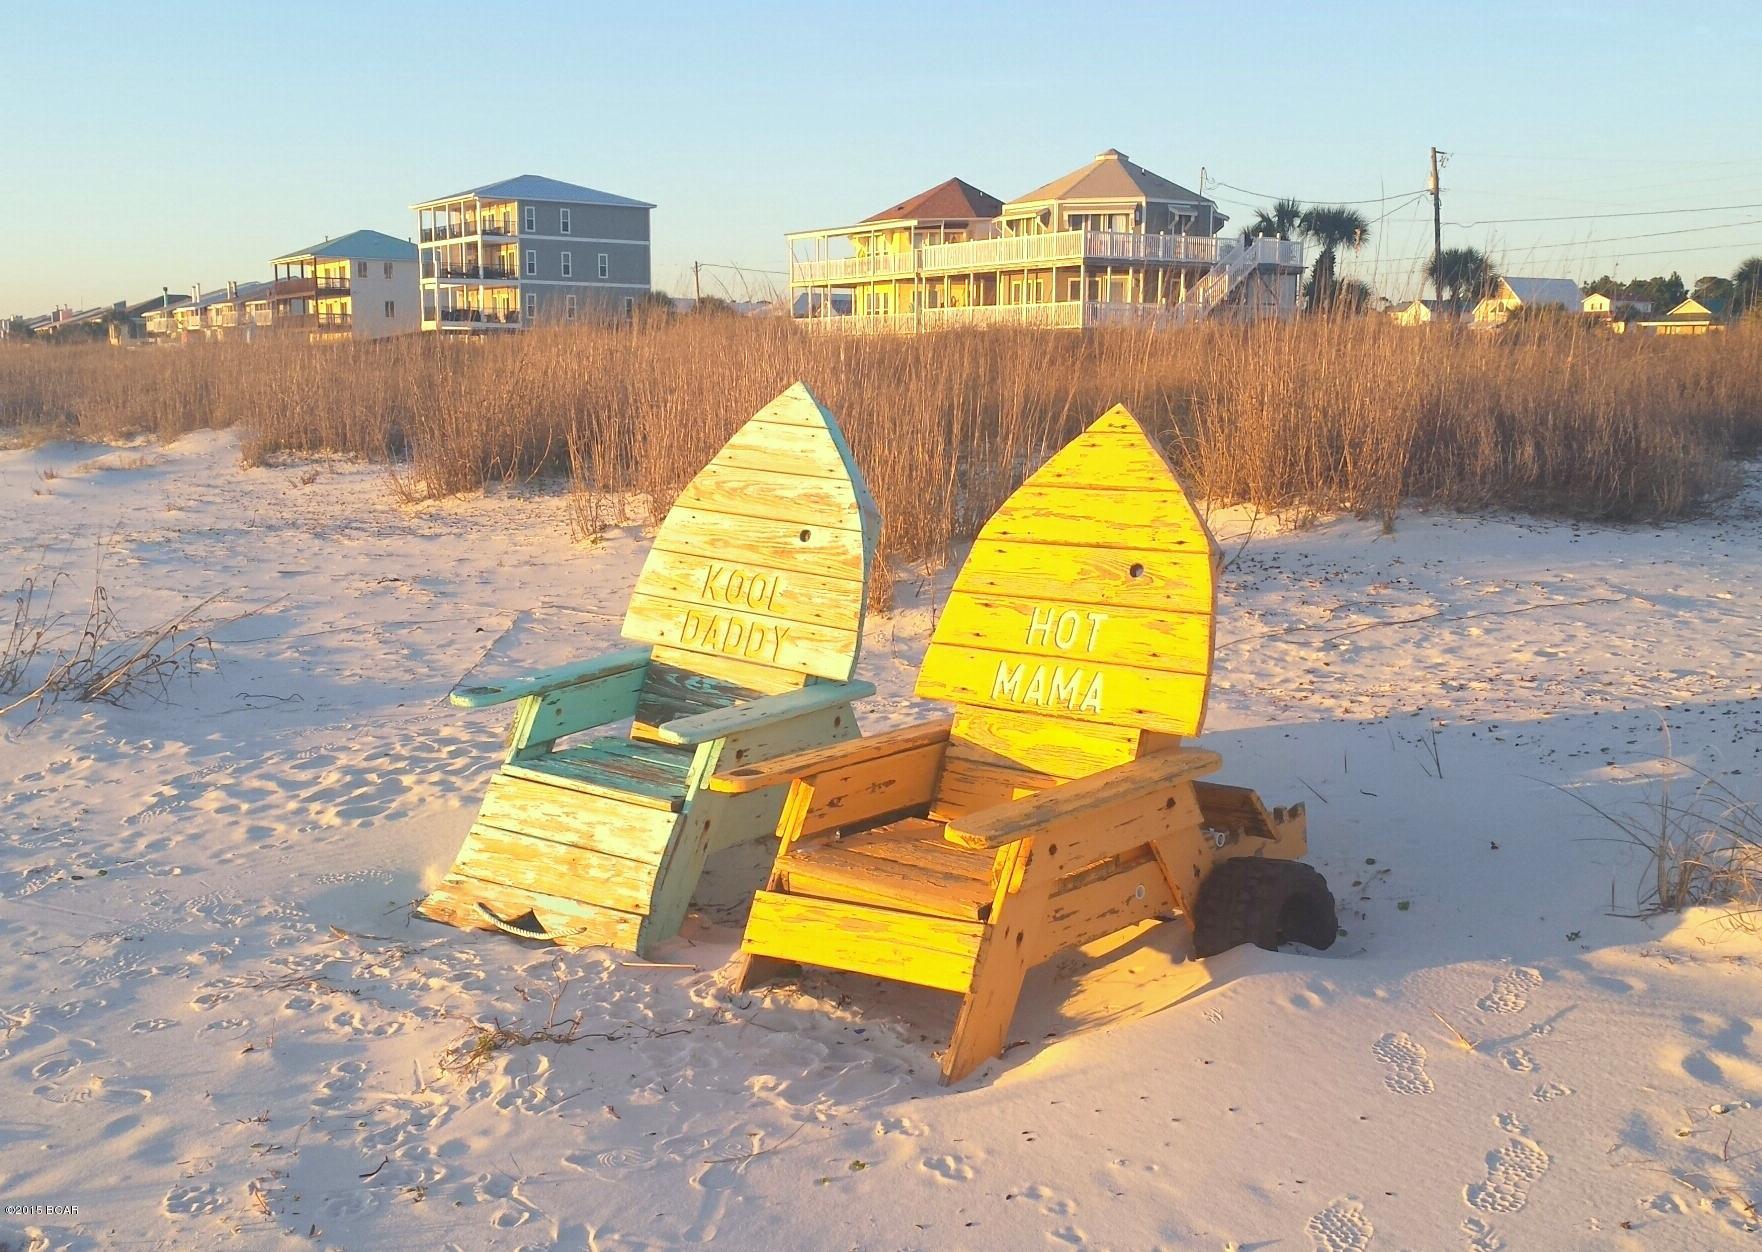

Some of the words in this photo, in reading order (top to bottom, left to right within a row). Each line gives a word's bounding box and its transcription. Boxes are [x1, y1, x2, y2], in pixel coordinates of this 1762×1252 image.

[702, 564, 786, 613] KOOL
[680, 609, 790, 662] DADDY
[1026, 607, 1109, 652] HOT
[990, 660, 1104, 714] MAMA
